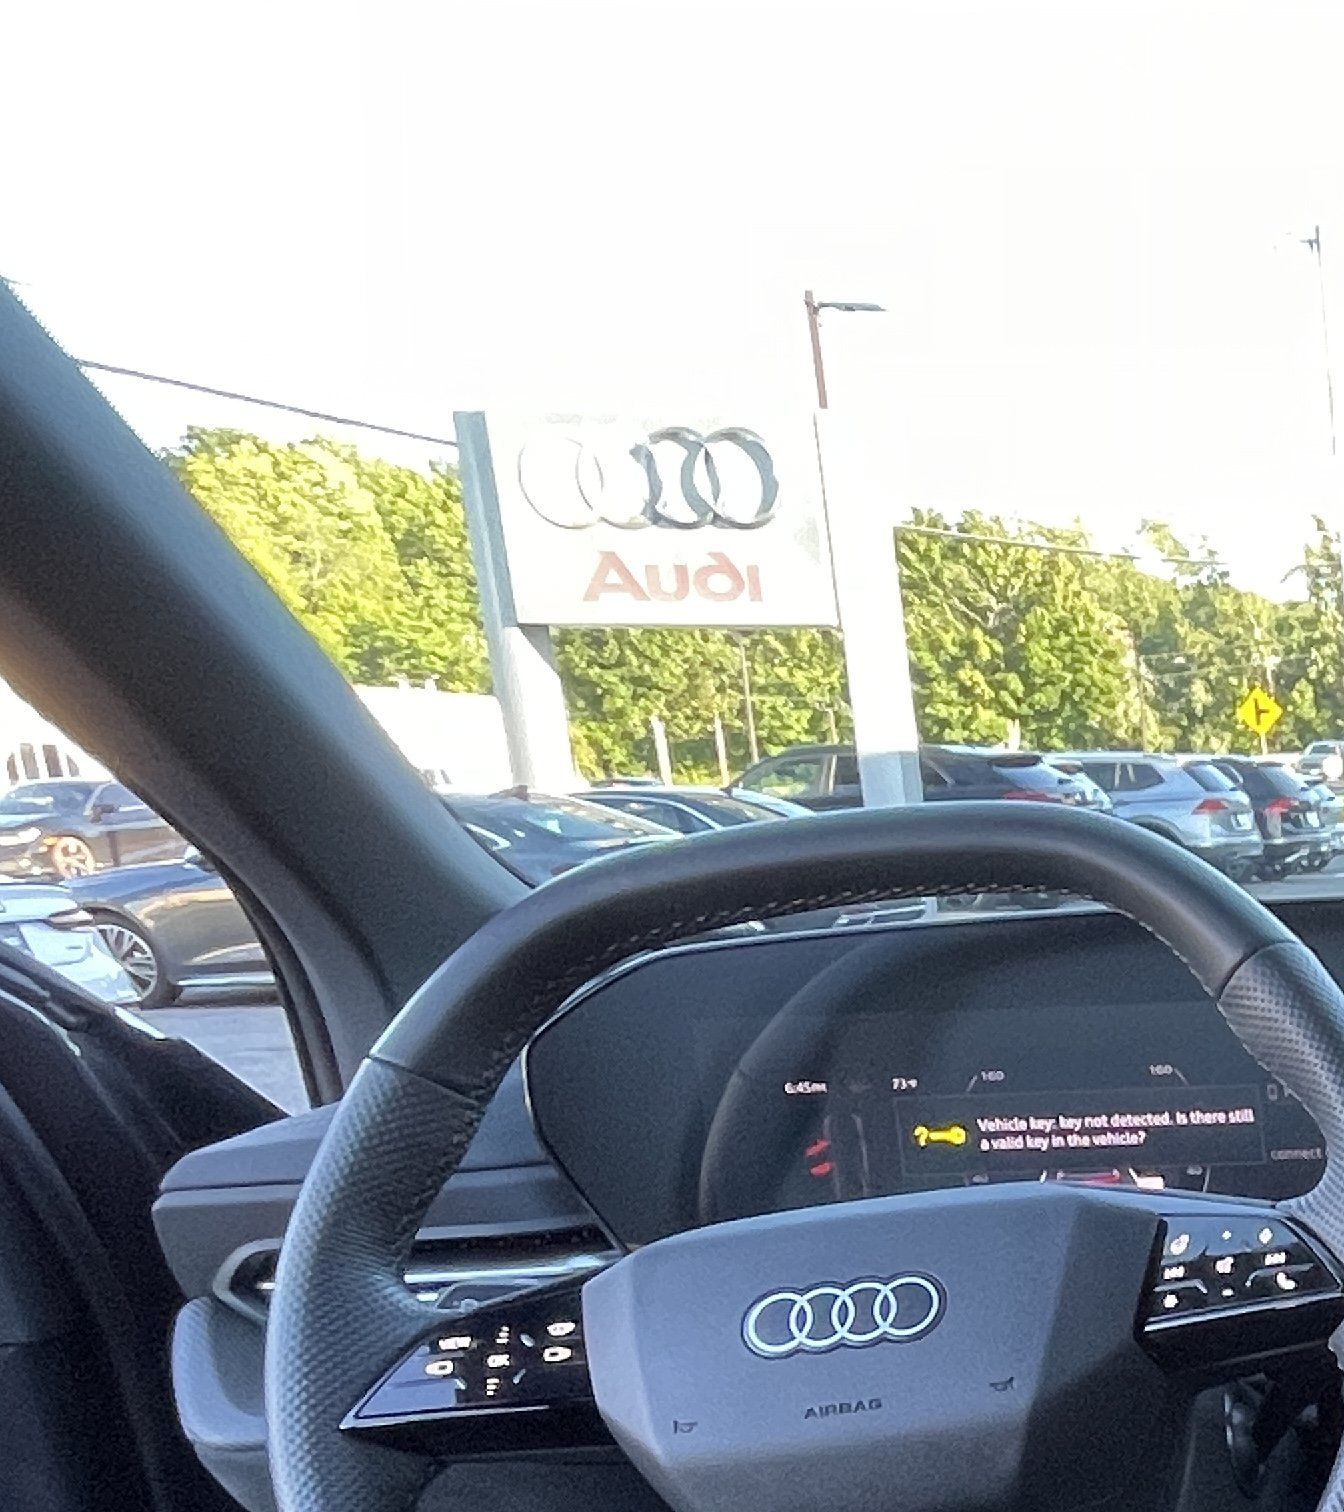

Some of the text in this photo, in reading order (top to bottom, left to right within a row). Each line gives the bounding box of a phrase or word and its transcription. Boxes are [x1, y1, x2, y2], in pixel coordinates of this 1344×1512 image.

[582, 551, 764, 603] Audi
[976, 1117, 1028, 1132] Vehicle
[1059, 1114, 1082, 1132] key
[1084, 1114, 1109, 1128] not
[1110, 1111, 1174, 1127] detected.
[1176, 1110, 1188, 1125] Is
[1189, 1110, 1227, 1125] there
[1228, 1107, 1255, 1123] still
[980, 1130, 1147, 1151] a valid key in the vehicle?
[803, 1398, 882, 1420] AIRBAG
